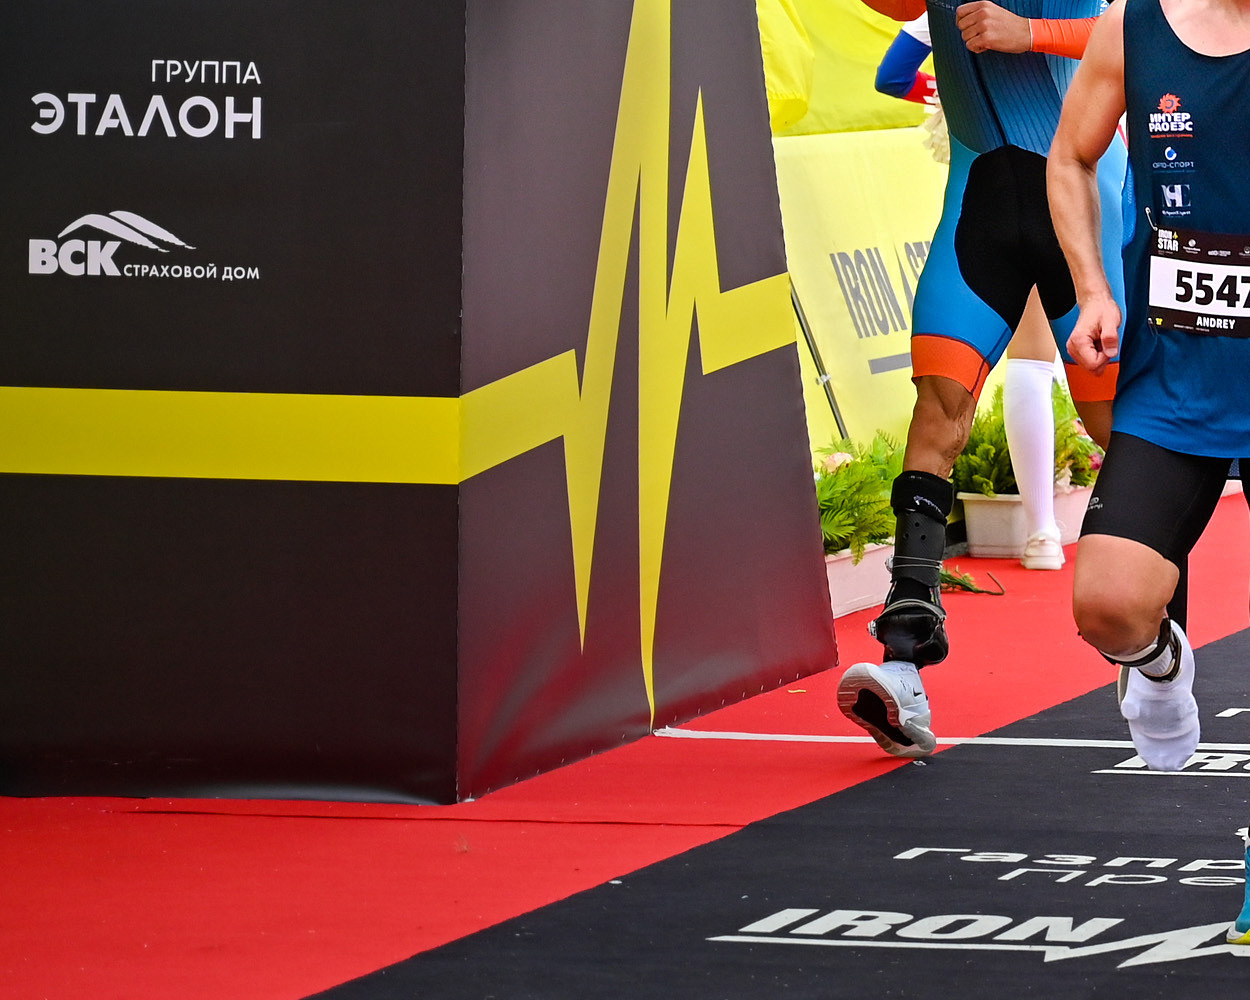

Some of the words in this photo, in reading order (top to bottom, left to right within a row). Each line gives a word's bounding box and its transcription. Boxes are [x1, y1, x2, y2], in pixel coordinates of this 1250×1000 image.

[151, 59, 262, 85] ГРУППА
[30, 92, 262, 140] ЭТАЛОН
[1149, 112, 1191, 123] ИНТЕР
[1157, 238, 1179, 252] STAR
[123, 263, 217, 279] СТРАХОВОЙ
[221, 266, 260, 281] ДОМ
[829, 246, 908, 339] IRON
[1196, 315, 1236, 330] ANDREY
[737, 908, 1125, 942] IRON
